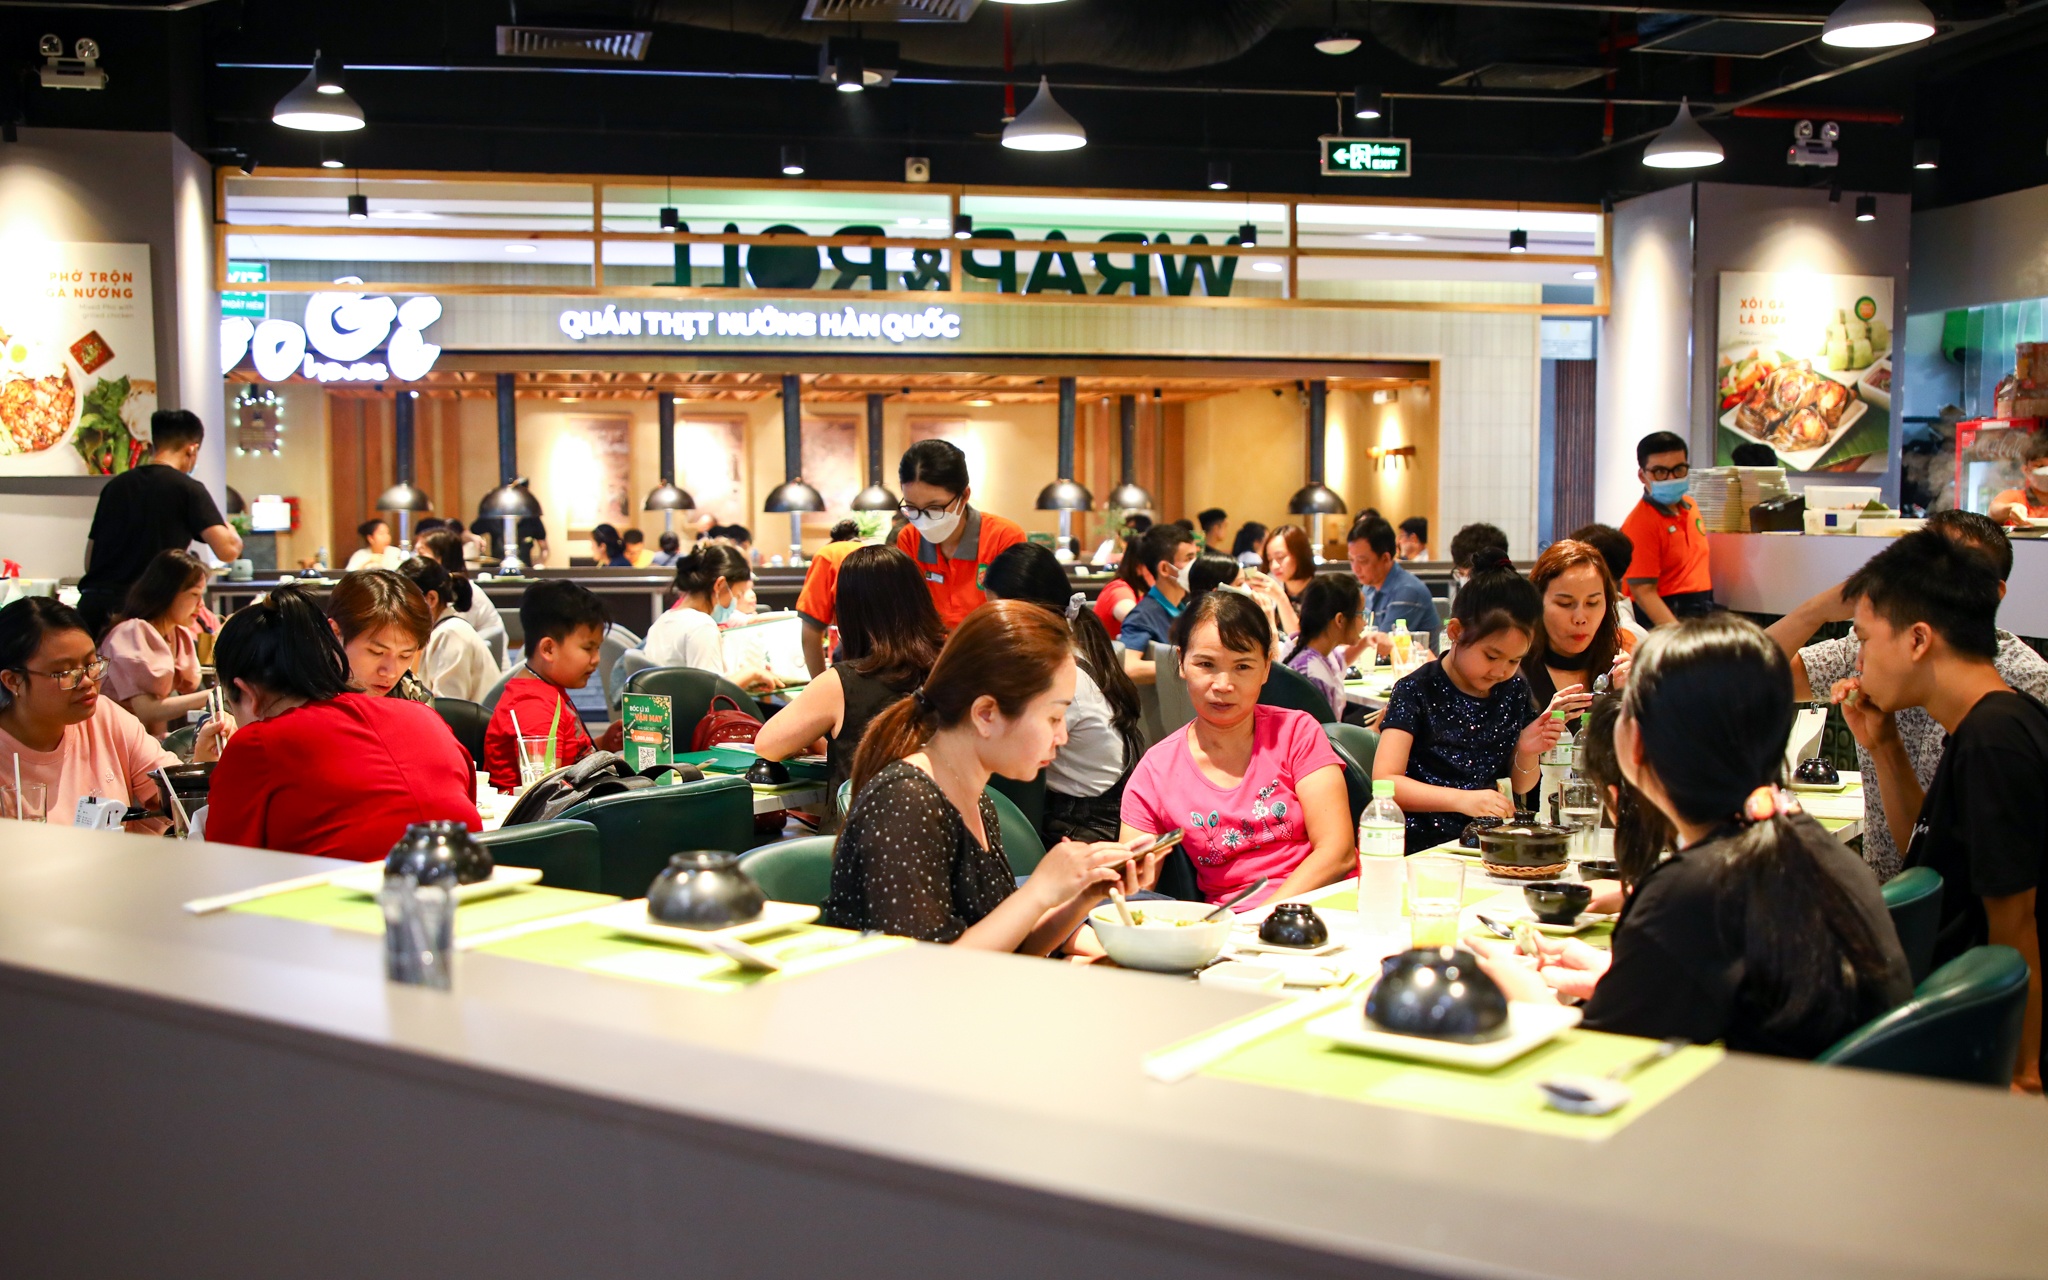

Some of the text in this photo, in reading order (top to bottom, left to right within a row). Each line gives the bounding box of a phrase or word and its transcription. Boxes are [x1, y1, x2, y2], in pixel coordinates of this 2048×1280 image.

[1372, 159, 1398, 170] EXIT
[90, 269, 133, 286] TRỘN
[74, 285, 134, 299] NƯỚNG
[1740, 297, 1763, 309] XÔI
[559, 304, 643, 340] QUÁN
[643, 311, 714, 341] THỊT
[820, 307, 882, 338] HÀN
[882, 307, 961, 343] QUỐC
